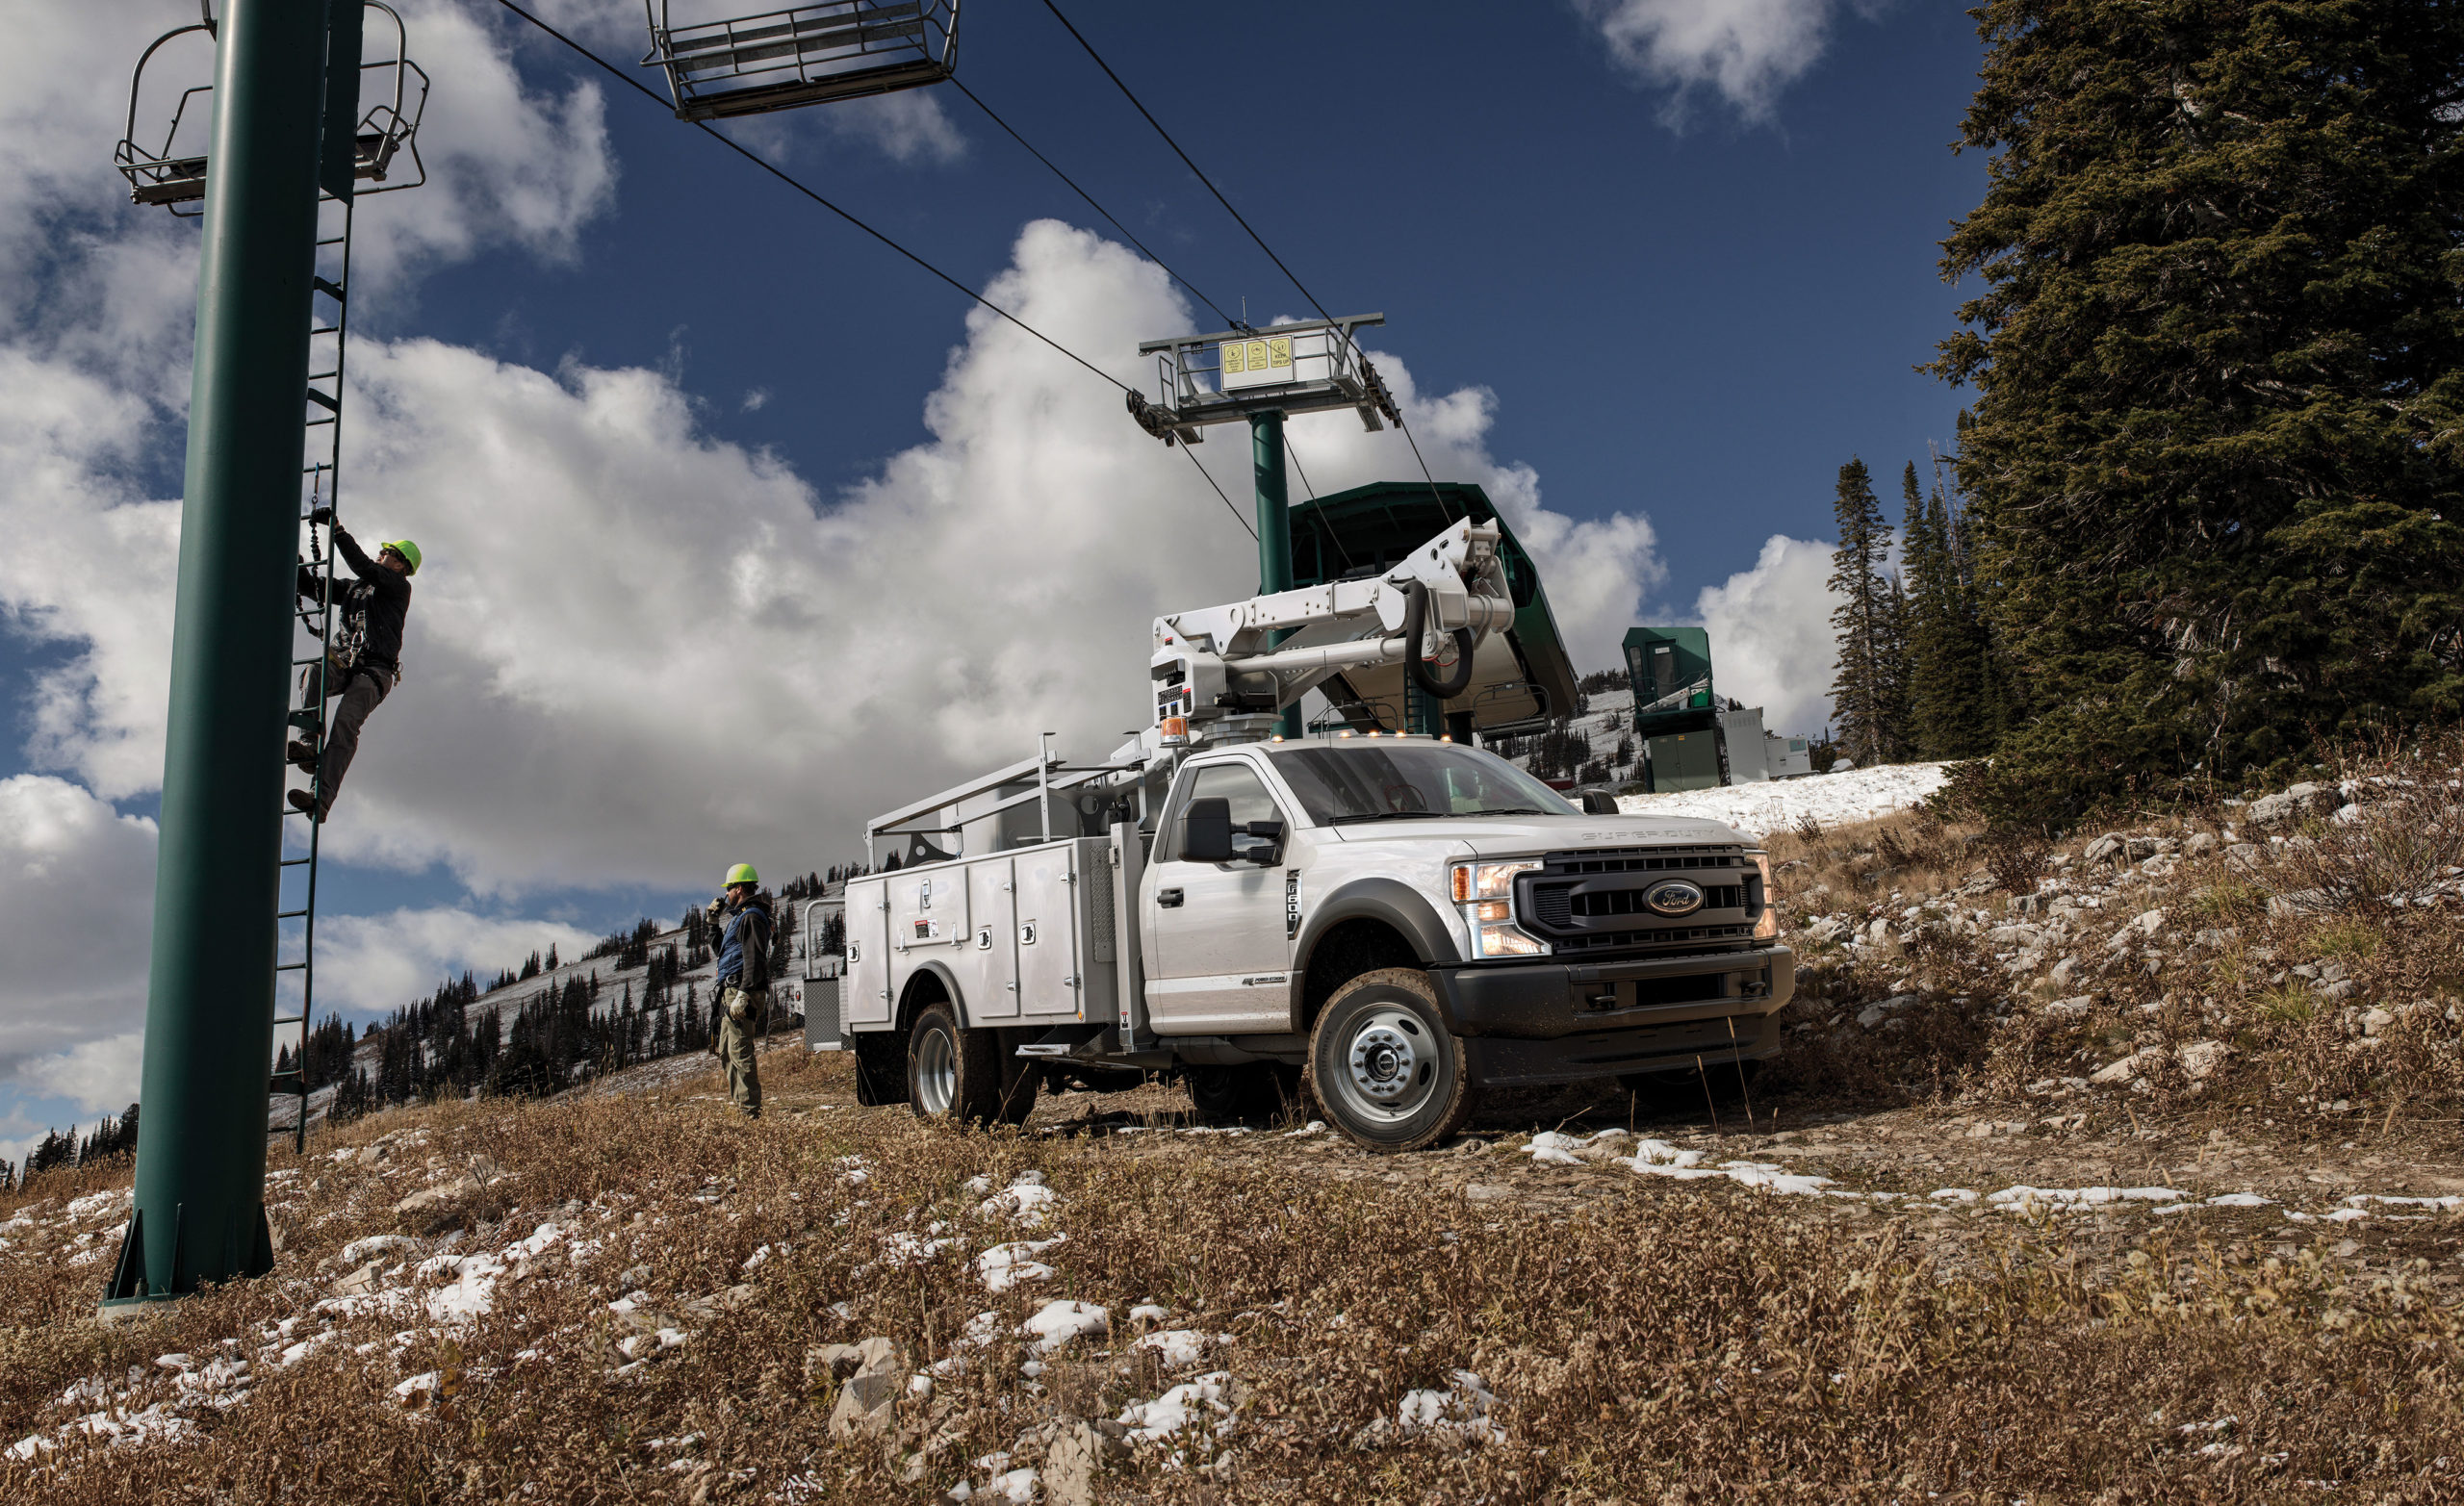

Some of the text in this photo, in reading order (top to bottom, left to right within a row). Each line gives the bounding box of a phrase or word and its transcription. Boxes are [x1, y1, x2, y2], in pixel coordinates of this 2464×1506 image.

[1581, 830, 1715, 841] SUPER DUTY
[1662, 890, 1690, 906] Ford
